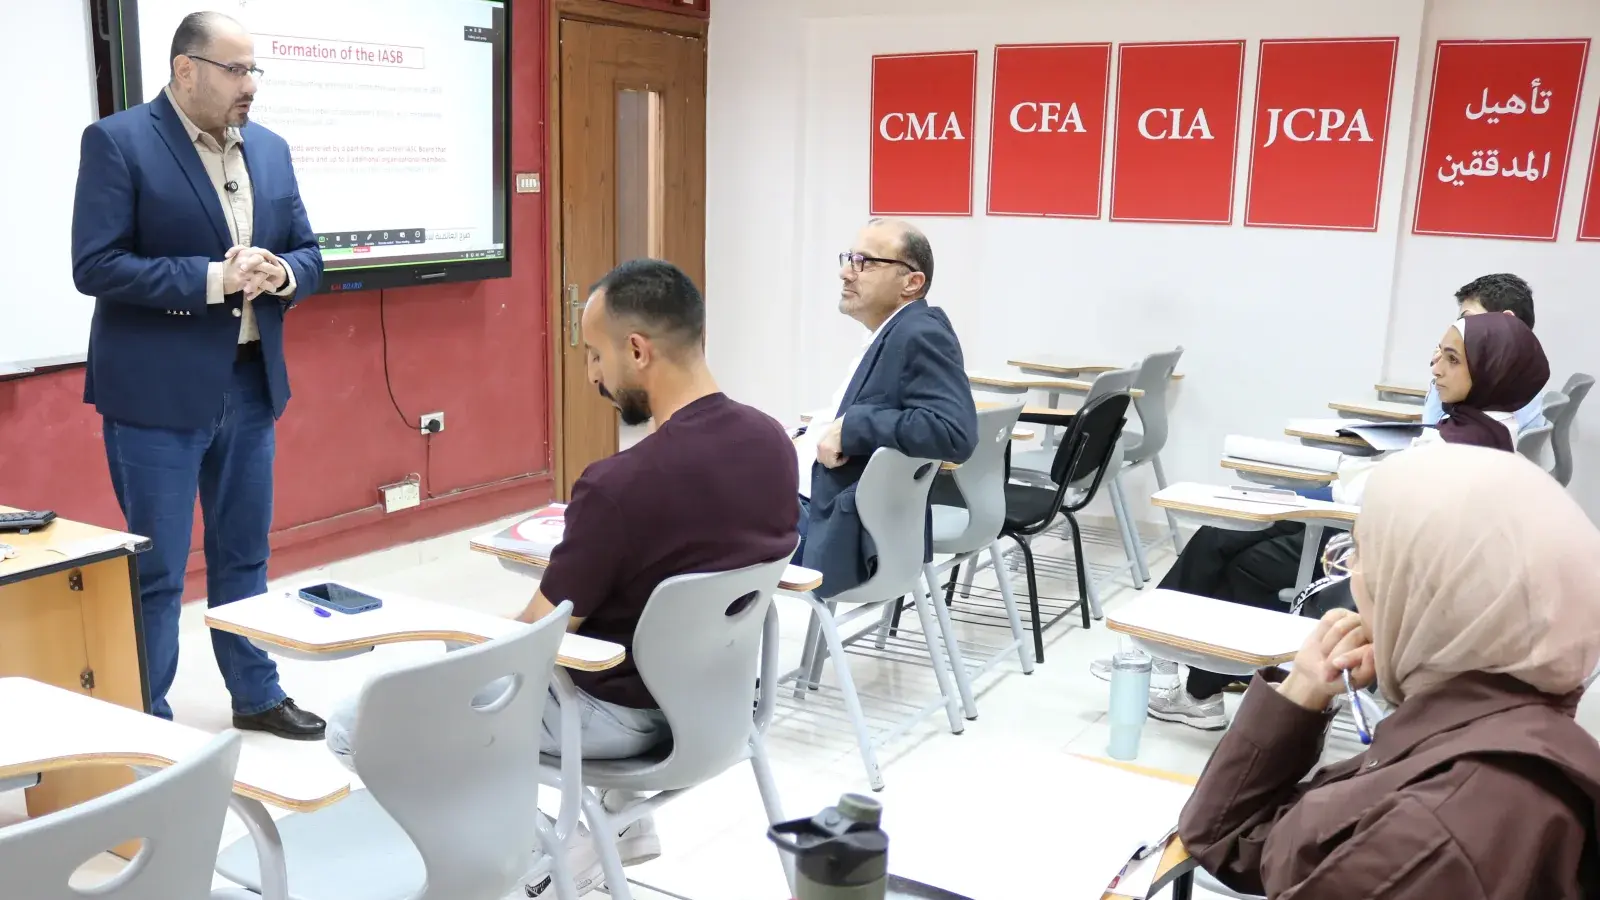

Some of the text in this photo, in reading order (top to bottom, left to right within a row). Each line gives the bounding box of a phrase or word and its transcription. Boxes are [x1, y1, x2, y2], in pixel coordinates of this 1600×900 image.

[272, 40, 404, 64] Formation of the IASB
[1009, 102, 1088, 133] CFA
[1465, 78, 1553, 124] تأهيل
[879, 111, 966, 142] CMA
[1137, 107, 1215, 141] CIA
[1263, 107, 1374, 148] JCPA
[1437, 150, 1552, 187] المدققين
